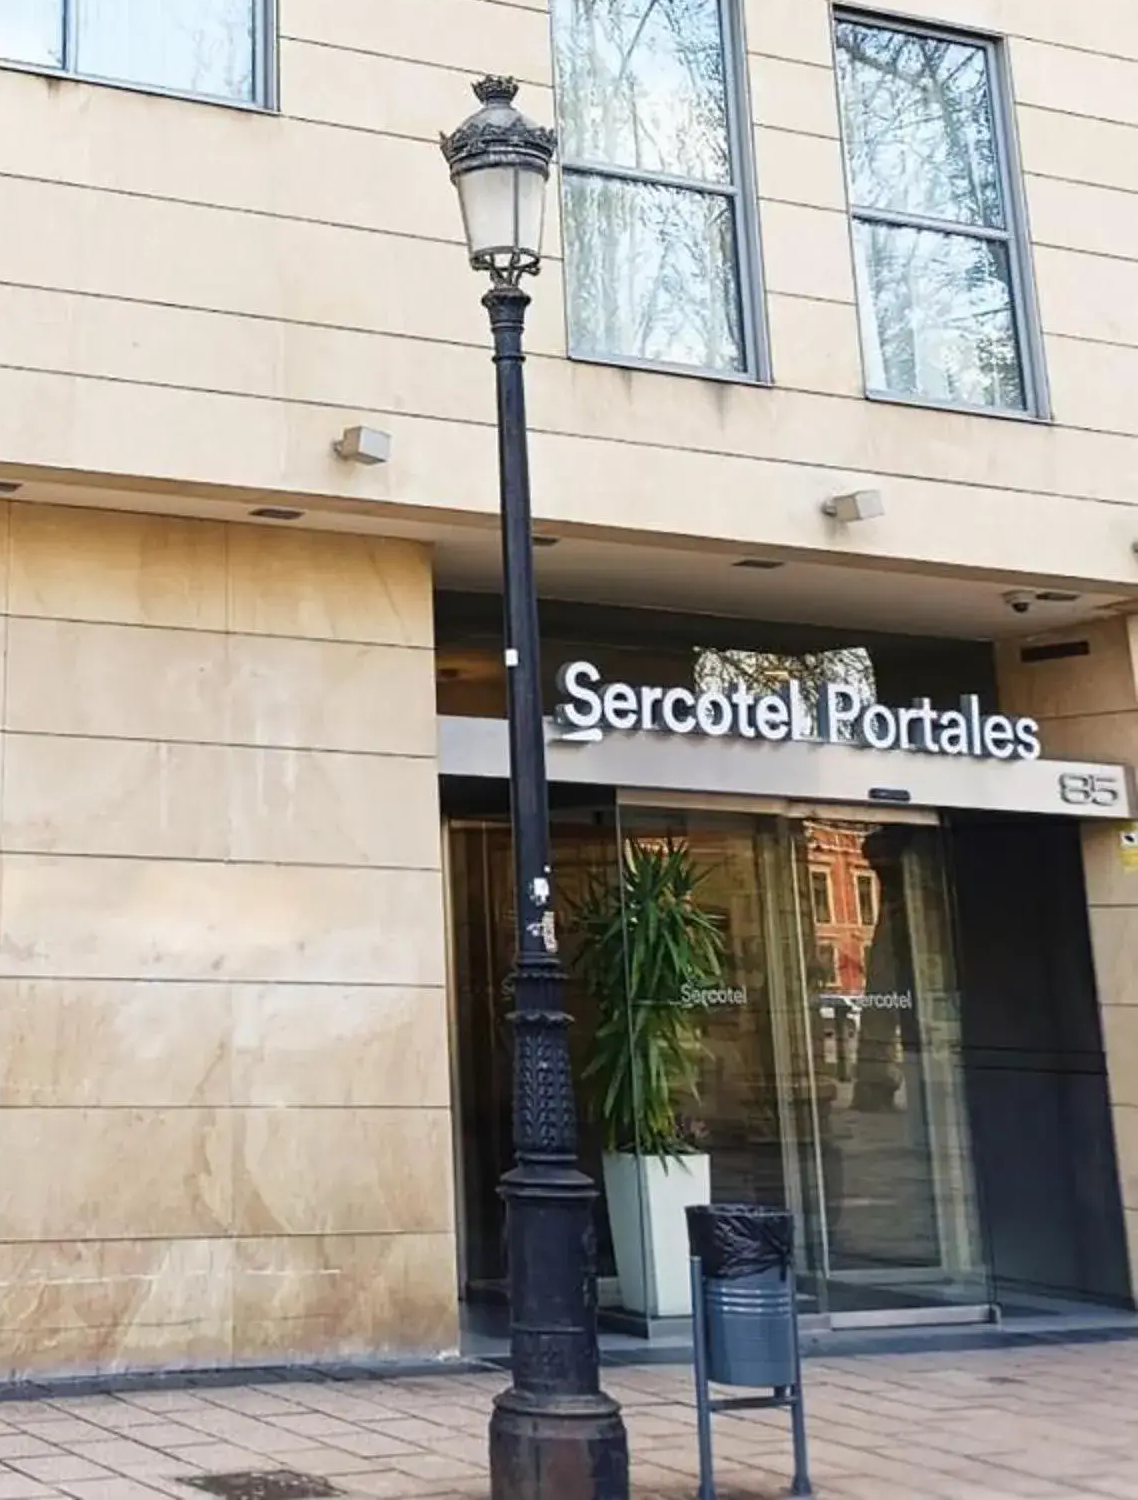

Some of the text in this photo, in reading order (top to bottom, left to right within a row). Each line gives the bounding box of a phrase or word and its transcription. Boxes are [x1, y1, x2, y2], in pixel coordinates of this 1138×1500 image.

[561, 660, 1042, 760] Sercotel Portales
[679, 984, 747, 1008] Sercotel
